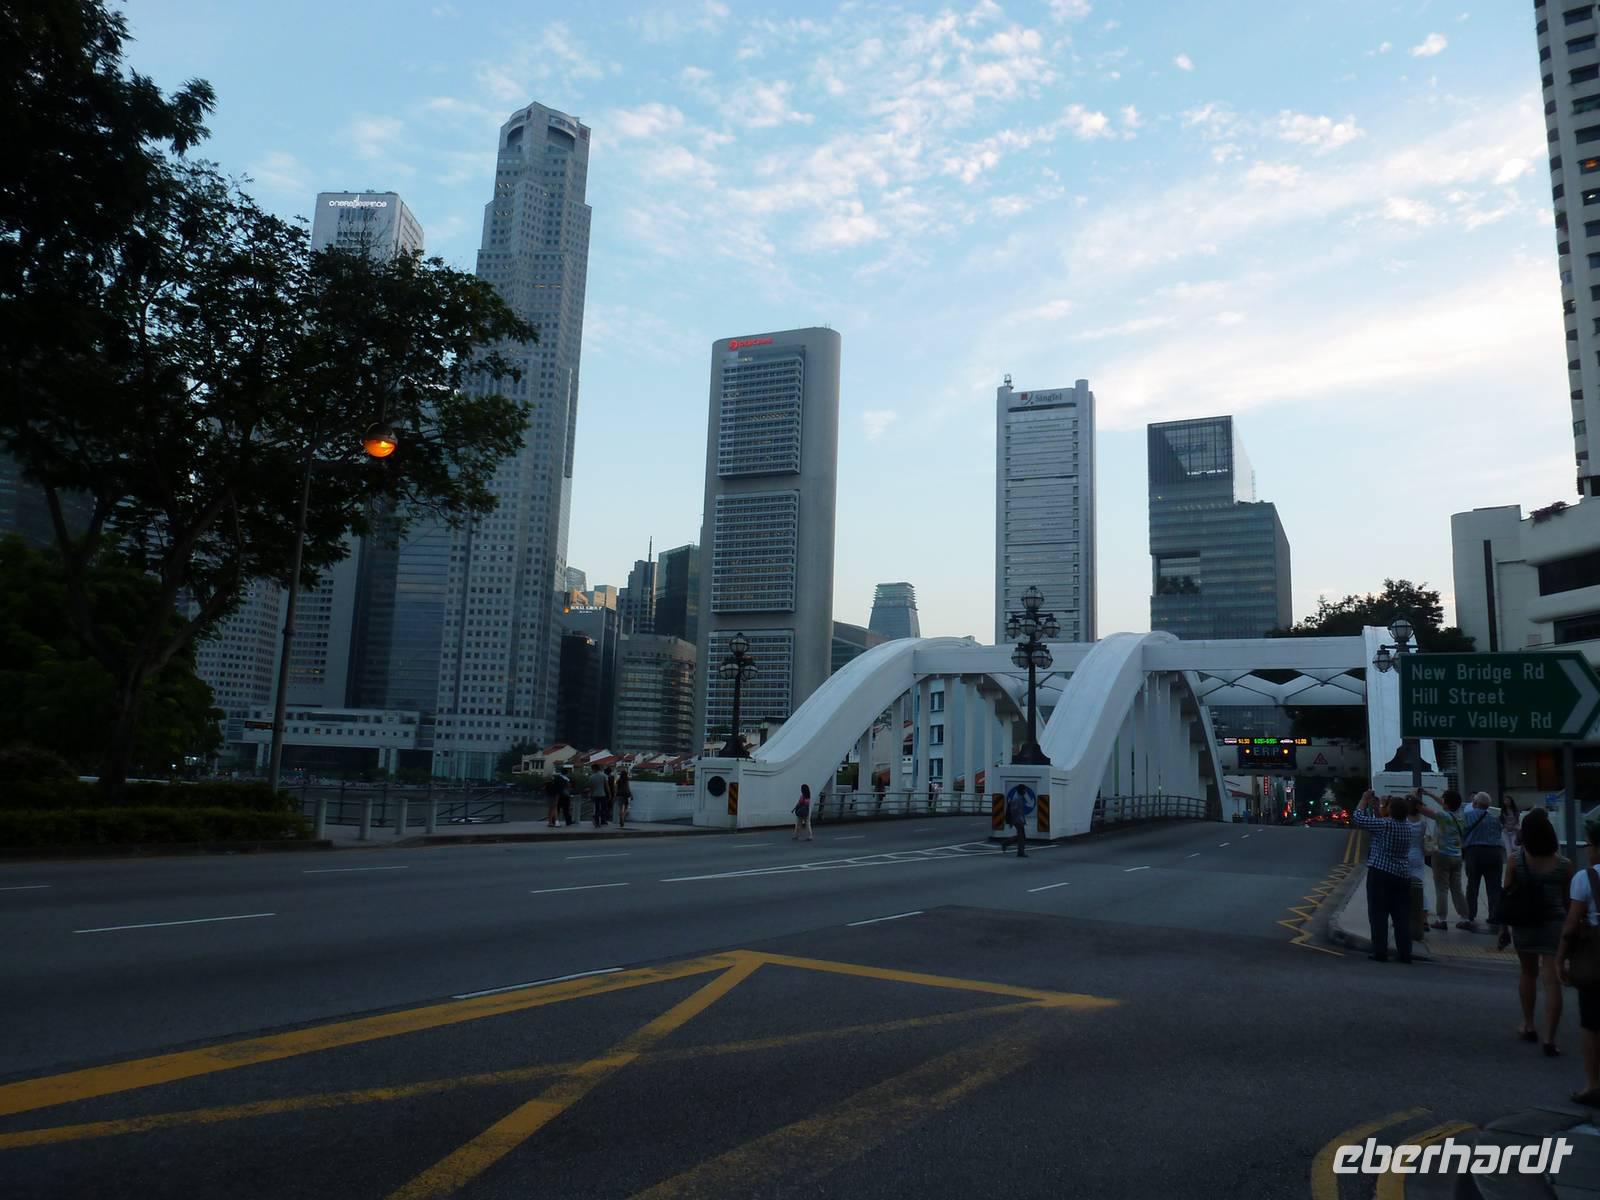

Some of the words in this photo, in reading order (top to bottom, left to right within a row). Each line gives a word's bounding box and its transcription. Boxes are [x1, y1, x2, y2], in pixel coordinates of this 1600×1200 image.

[1035, 392, 1062, 402] SingTel
[1412, 663, 1446, 680] New
[1457, 663, 1512, 683] Bridge
[1523, 662, 1545, 680] Rd
[1412, 687, 1438, 705] Hill
[1449, 687, 1505, 705] Street
[1412, 711, 1456, 728] River
[1467, 711, 1518, 732] Valley
[1531, 711, 1552, 729] Rd
[1253, 746, 1280, 757] ERP
